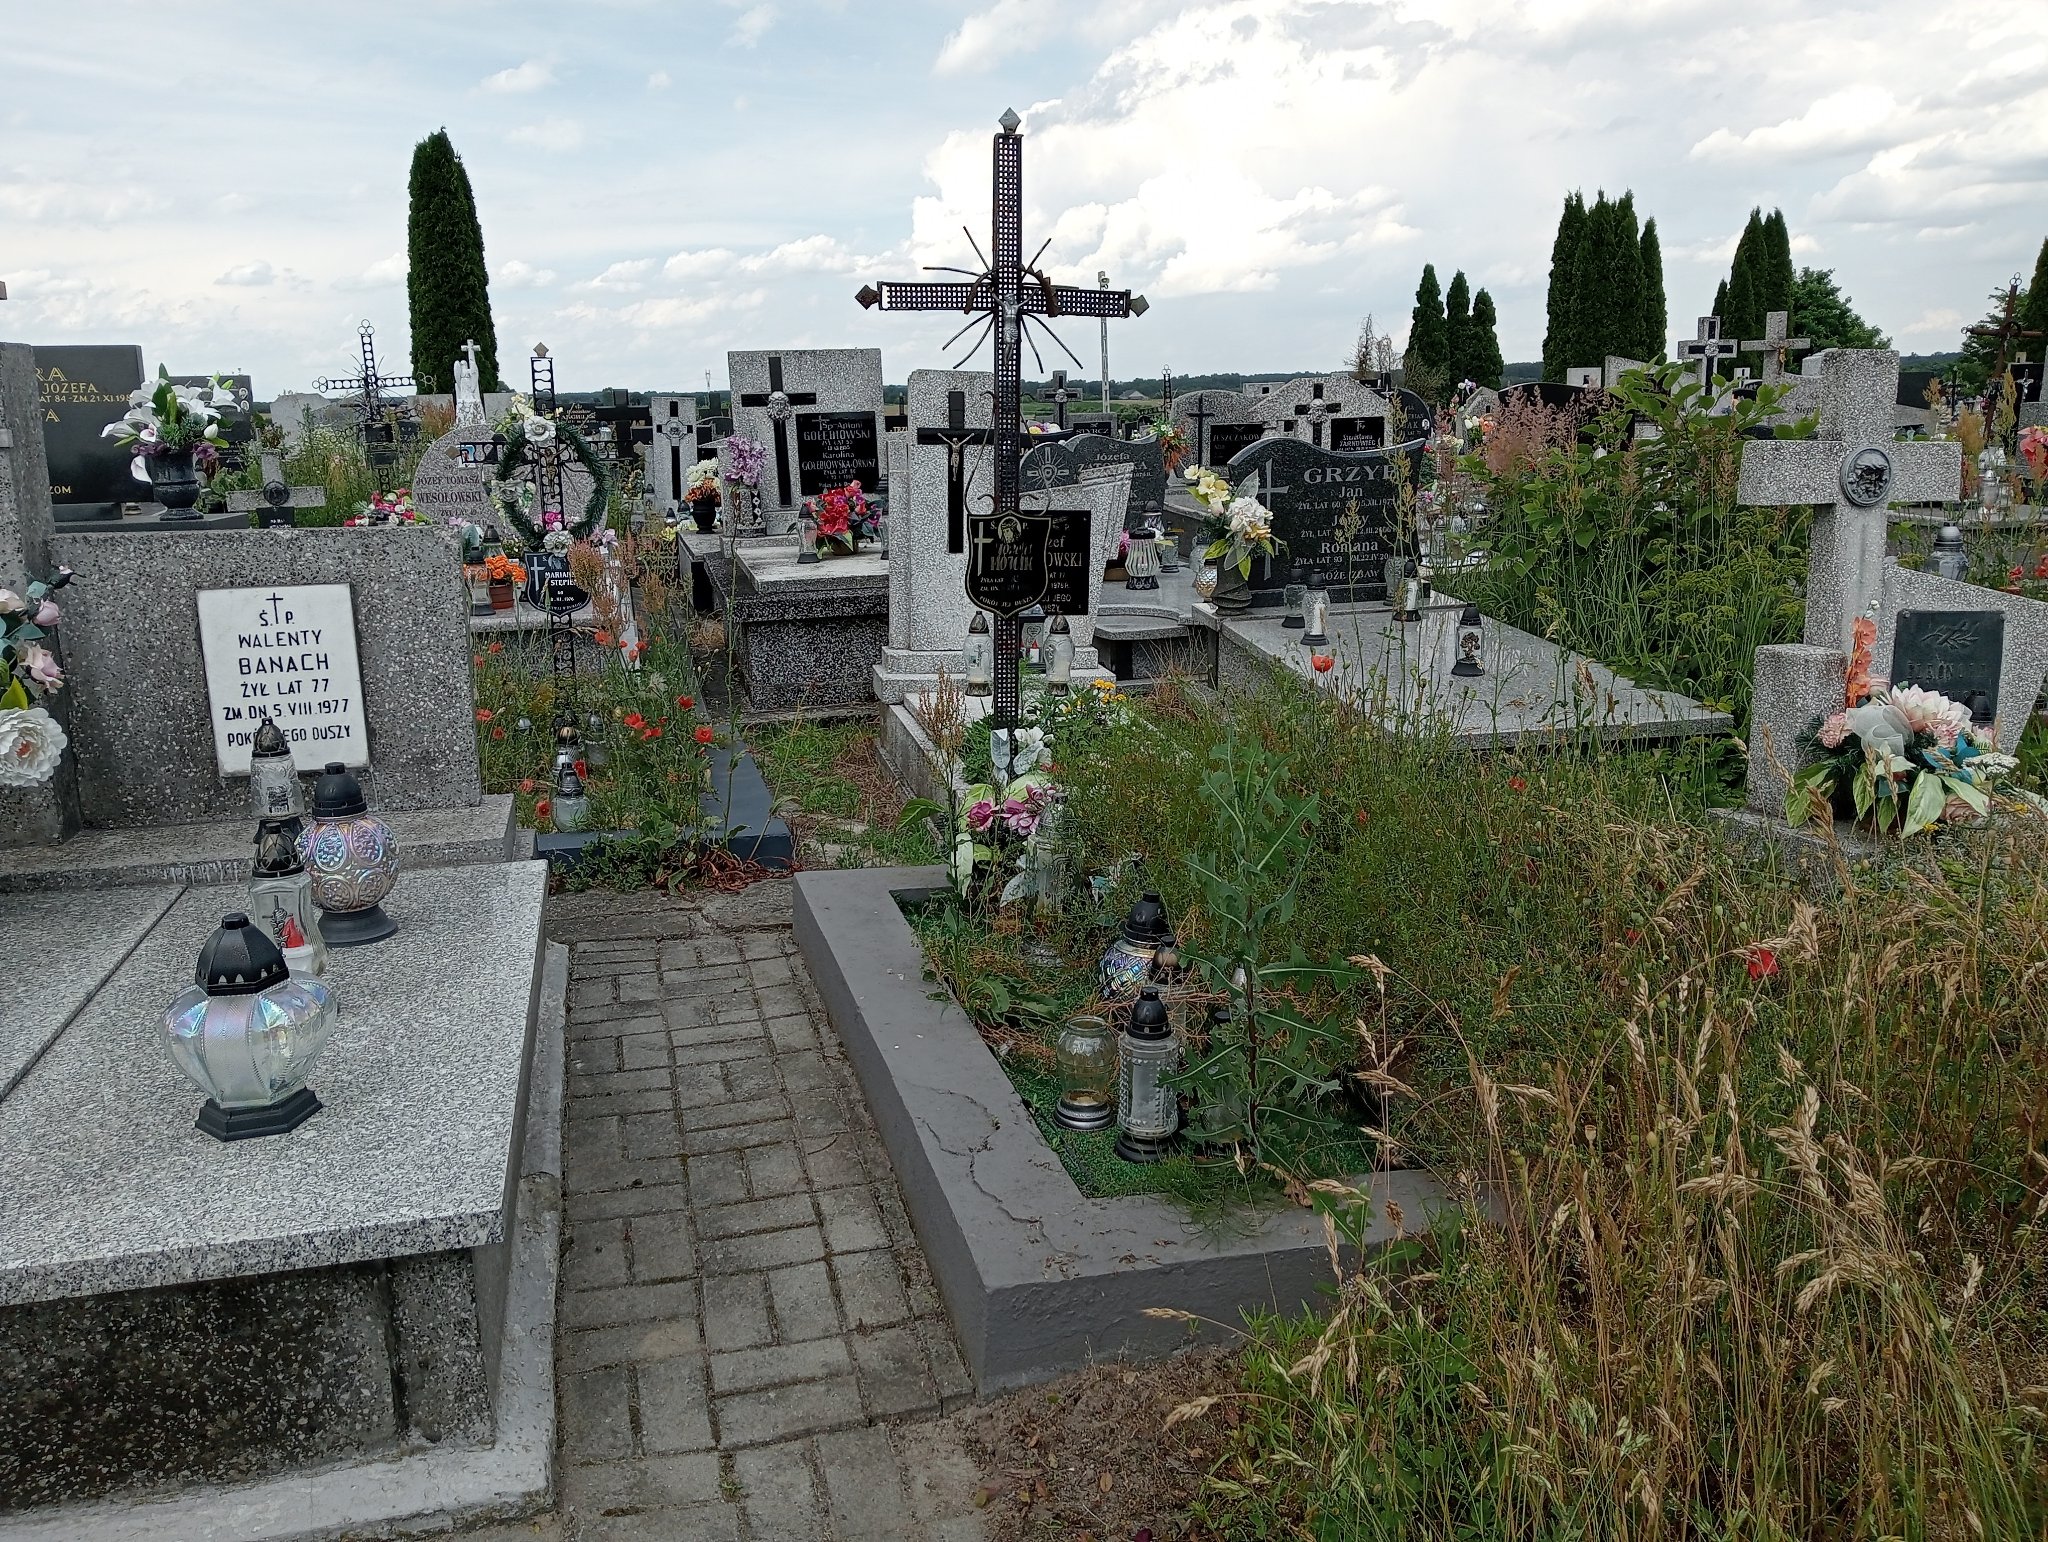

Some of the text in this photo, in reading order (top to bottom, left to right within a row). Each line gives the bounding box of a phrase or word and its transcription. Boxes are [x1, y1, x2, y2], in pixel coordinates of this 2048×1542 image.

[822, 451, 855, 459] Karolina
[1094, 452, 1130, 461] Józefa
[416, 491, 482, 504] WESOŁOWSKI
[1339, 486, 1363, 498] Jan
[1320, 541, 1378, 554] Romana
[1316, 556, 1331, 564] LAT
[238, 629, 322, 648] WALENTY
[238, 653, 329, 675] BANACH
[240, 678, 329, 698] ŻYŁ LAT 77
[227, 725, 351, 747] POK EGO DUSZY
